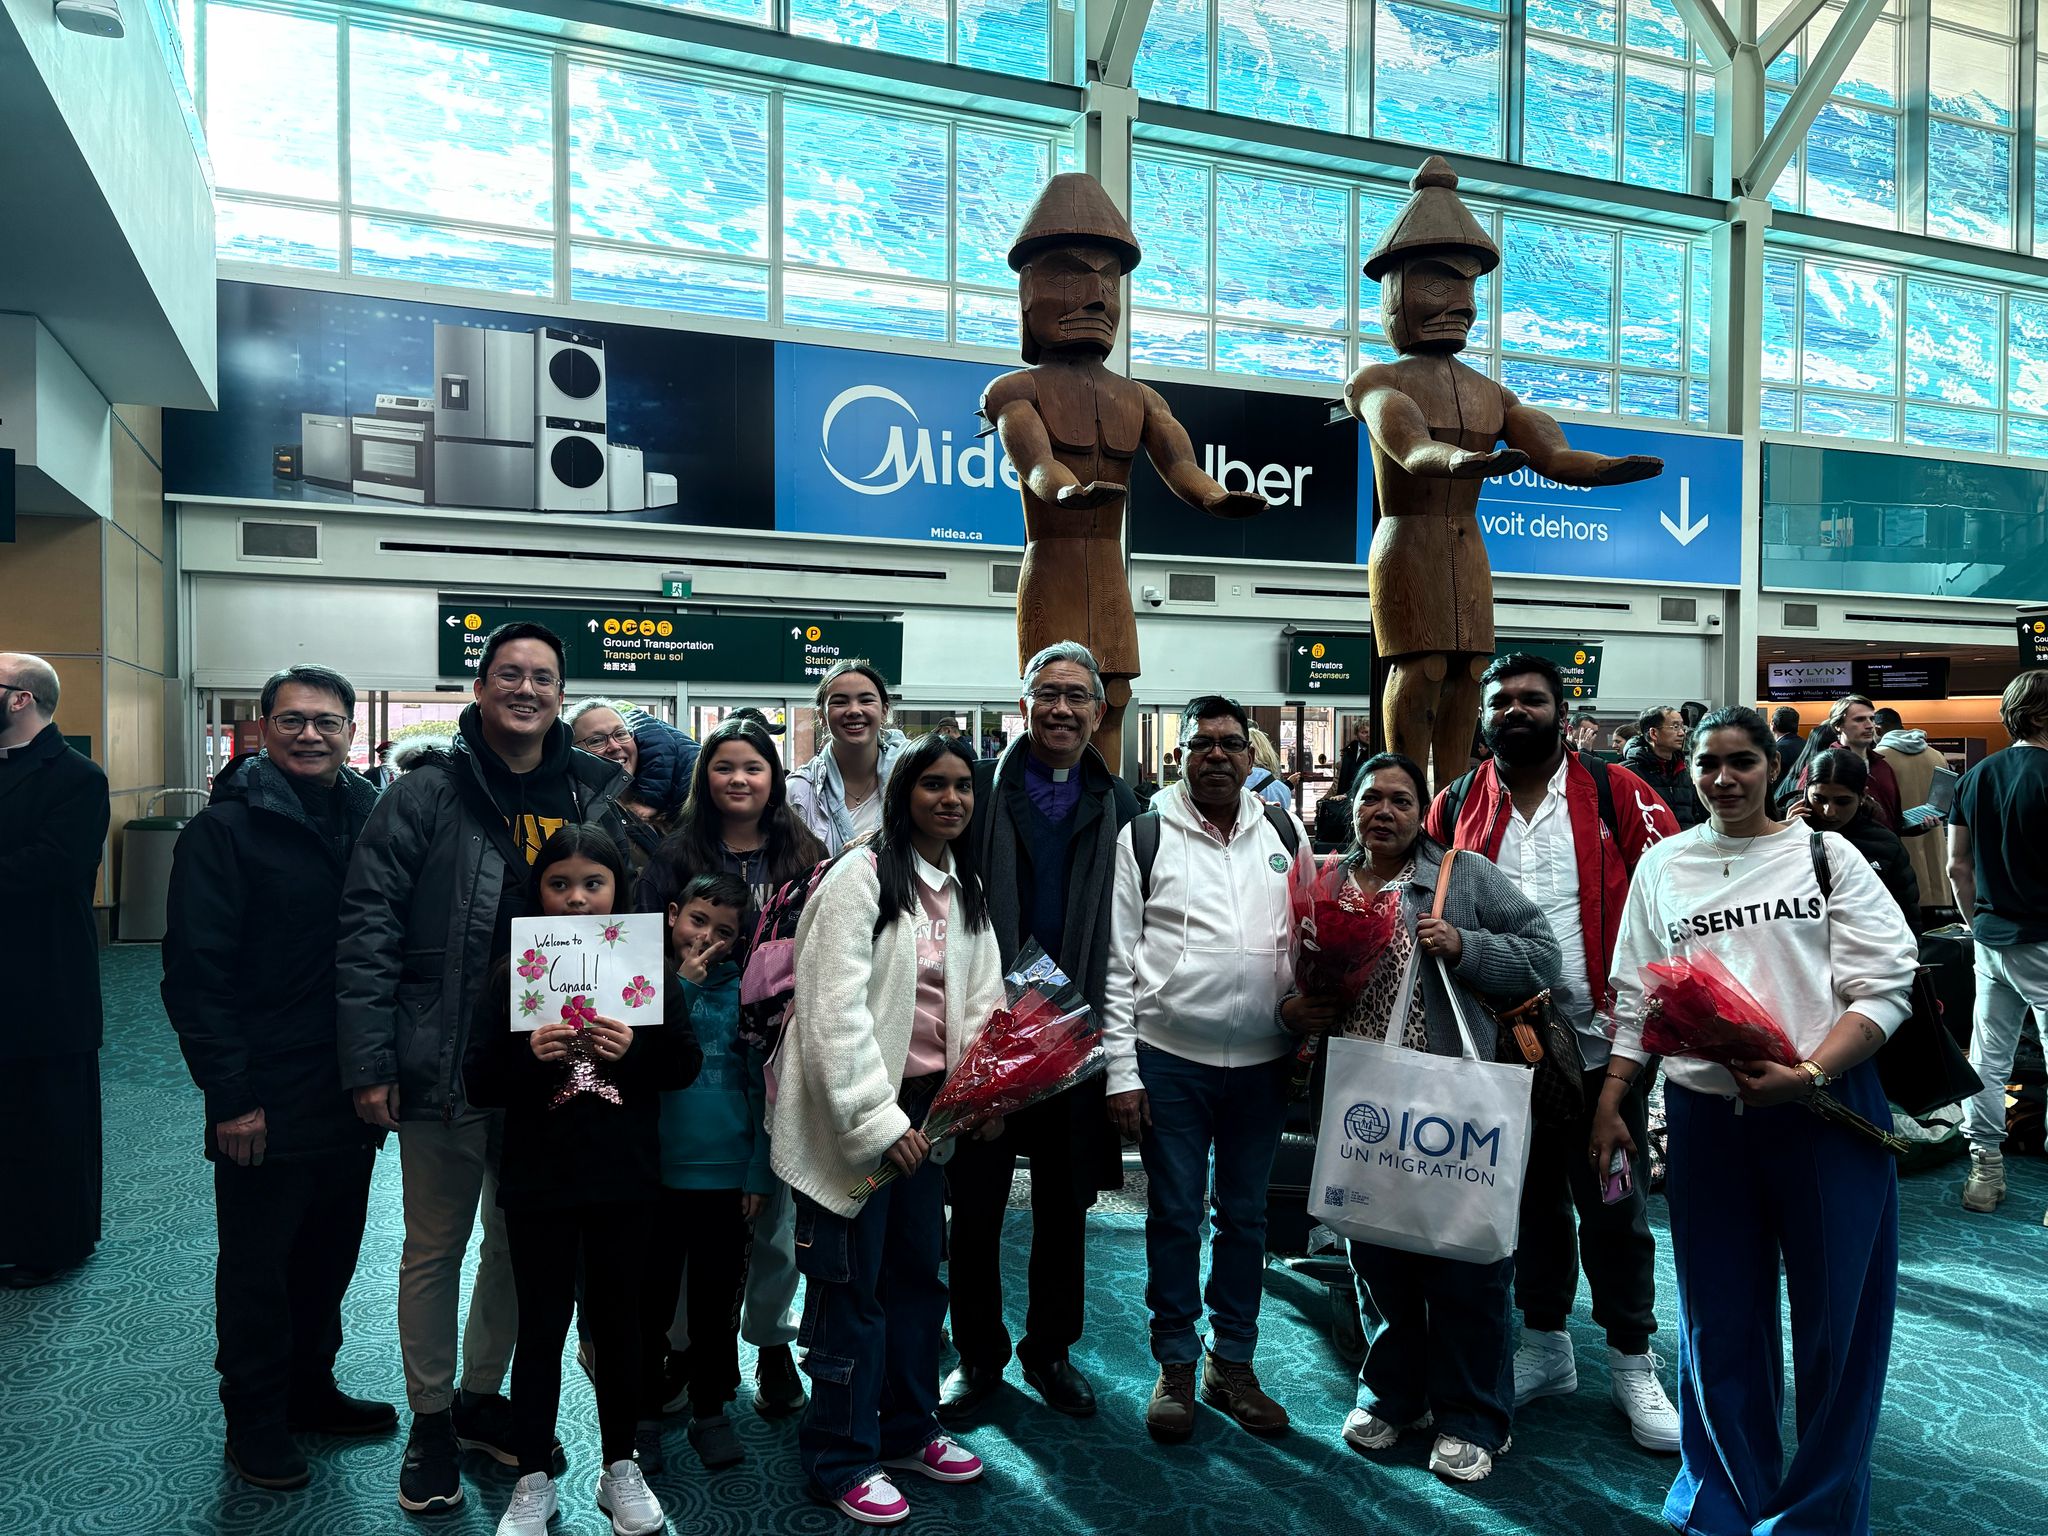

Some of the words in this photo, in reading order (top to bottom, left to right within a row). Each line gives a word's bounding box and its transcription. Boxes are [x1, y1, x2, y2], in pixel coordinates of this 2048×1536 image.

[1508, 469, 1592, 492] outs
[930, 527, 983, 540] Midea.ca
[1481, 511, 1525, 536] voit
[1529, 513, 1609, 542] dehors
[603, 637, 641, 648] Ground
[643, 638, 714, 651] Transportation
[805, 644, 840, 656] Parking
[603, 649, 651, 661] Transport
[653, 653, 666, 661] au
[669, 652, 684, 661] sol
[1310, 660, 1344, 670] Elevators
[1773, 667, 1846, 677] SKYLYNX
[1309, 671, 1350, 680] Ascenseurs
[1667, 897, 1821, 944] ESSENTIALS
[534, 933, 571, 949] Welcome
[572, 933, 583, 946] to
[549, 952, 599, 994] Canada!
[1398, 1111, 1501, 1167] IOM
[1340, 1143, 1369, 1163] UN
[1378, 1151, 1496, 1187] MIGRATION
